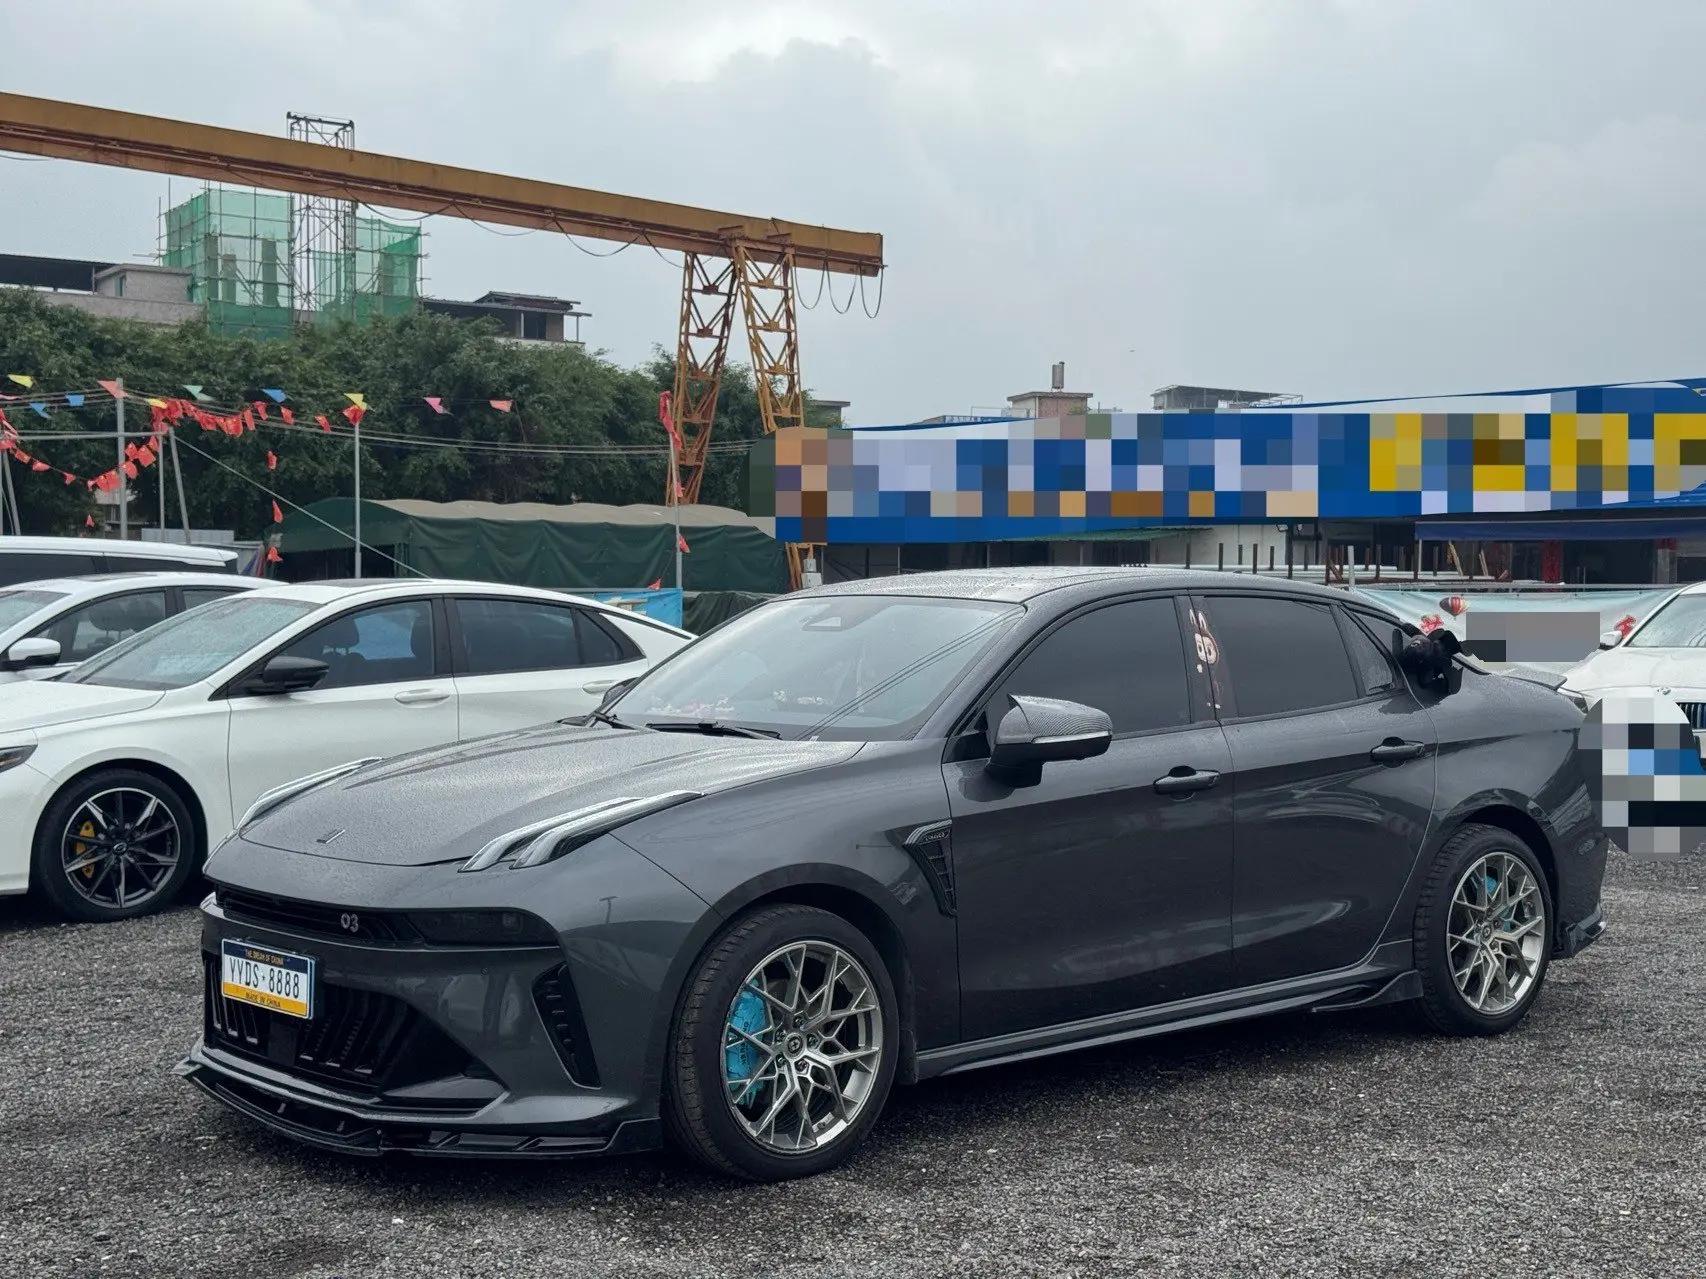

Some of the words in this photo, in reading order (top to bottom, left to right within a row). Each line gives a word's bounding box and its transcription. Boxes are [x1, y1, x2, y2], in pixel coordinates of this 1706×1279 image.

[341, 913, 359, 932] 03
[230, 957, 259, 988] YYDS
[269, 967, 299, 998] 8888
